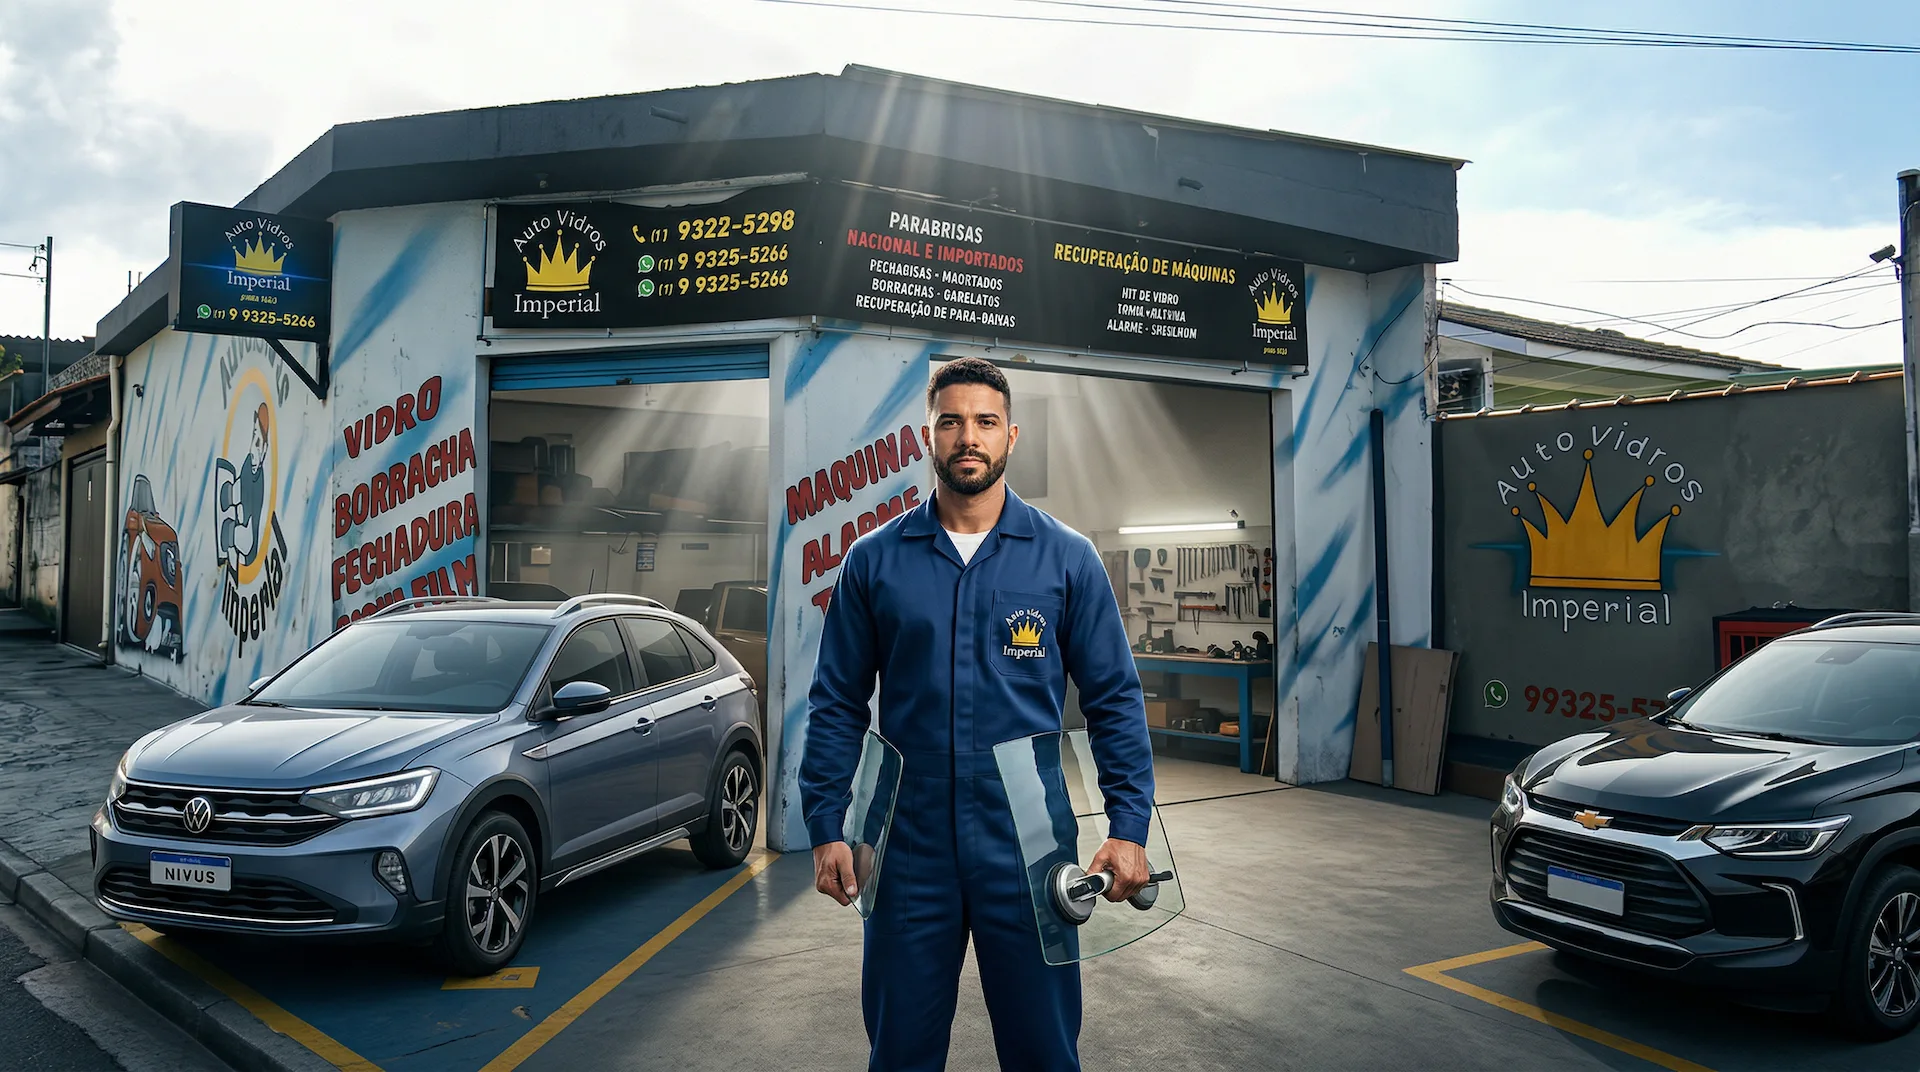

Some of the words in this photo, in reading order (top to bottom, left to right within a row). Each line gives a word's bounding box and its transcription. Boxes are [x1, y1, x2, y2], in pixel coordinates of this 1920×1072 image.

[225, 220, 254, 243] Auto
[257, 217, 294, 250] Vidros
[513, 217, 551, 253] Auto
[557, 210, 606, 252] Vidros
[678, 209, 795, 241] 9322-5298
[889, 211, 983, 244] PARABRISAS
[678, 253, 689, 271] 9
[695, 244, 788, 269] 9325-5266
[847, 229, 920, 257] NACIONAL
[924, 243, 934, 259] E
[937, 245, 1024, 273] IMPORTADOS
[1054, 242, 1149, 275] RECUPERAÇÃO
[1152, 259, 1169, 276] DE
[1171, 259, 1236, 285] MÁQUINAS
[227, 270, 291, 292] Imperial
[678, 278, 689, 295] 9
[695, 269, 789, 294] 9325-5266
[872, 278, 934, 298] BORRACHAS
[944, 289, 1000, 308] GARELATOS
[942, 270, 1003, 290] MAORTADOS
[1248, 271, 1269, 296] Auto
[1270, 268, 1299, 299] Vidros
[514, 292, 601, 319] Imperial
[855, 294, 931, 318] RECUPERAÇÃO
[934, 305, 947, 320] DE
[1139, 290, 1151, 302] DE
[229, 308, 238, 320] 9
[242, 309, 316, 328] 9325-5266
[1107, 319, 1143, 334] ALARME
[1252, 323, 1297, 343] Imperial
[343, 375, 442, 459] VIDRO
[786, 424, 923, 525] MAQUINA
[1496, 432, 1575, 505] Auto
[1591, 421, 1703, 502] Vidros
[334, 427, 477, 538] BORRACHA
[332, 493, 480, 603] FECHADURA
[1522, 589, 1671, 633] Imperial
[1003, 645, 1045, 659] Imperial
[165, 867, 215, 884] NIVUS
